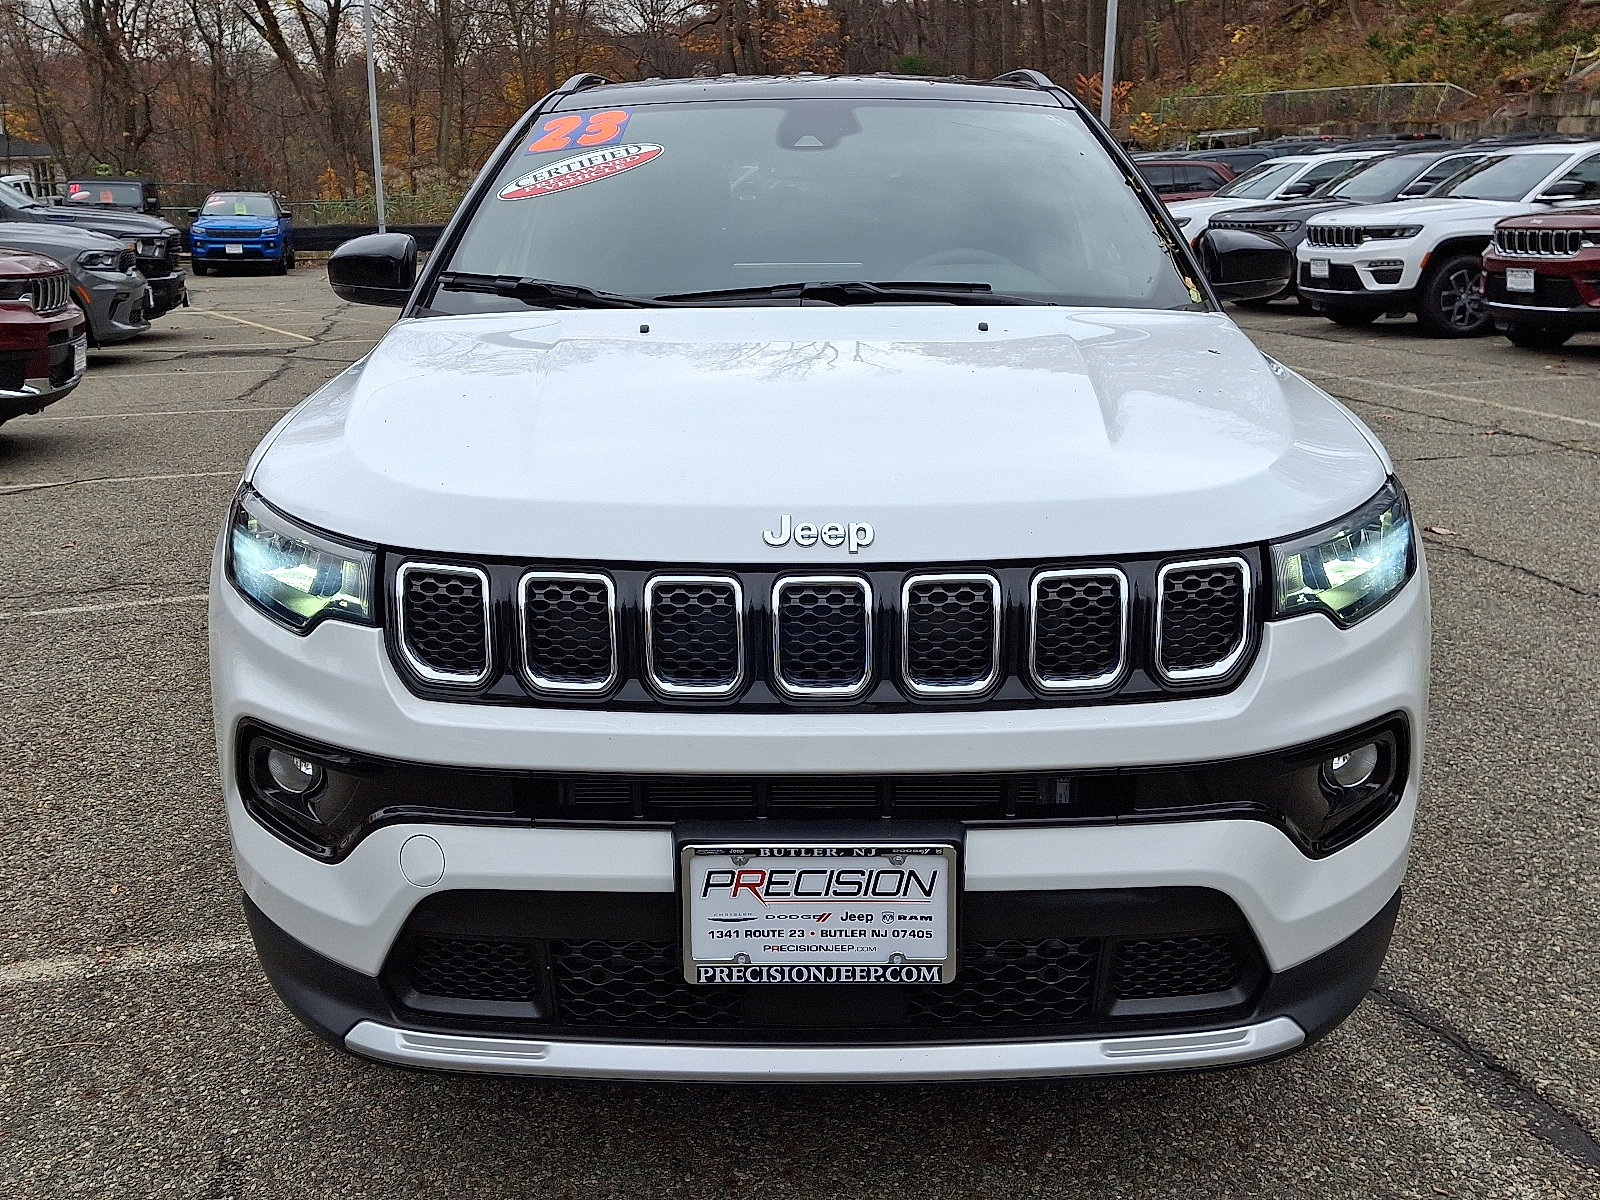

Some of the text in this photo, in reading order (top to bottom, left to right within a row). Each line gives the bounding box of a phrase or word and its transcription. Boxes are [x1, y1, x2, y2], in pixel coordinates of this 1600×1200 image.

[528, 110, 629, 153] 23
[515, 144, 642, 188] CERTIFIED
[545, 160, 628, 191] VEHICLE
[762, 514, 875, 554] Jeep
[852, 848, 877, 857] NJ
[701, 868, 939, 909] PRECISION
[840, 911, 874, 923] Jeep
[708, 929, 933, 939] 1341 ROUTE 23 BUTLER NJ 07405
[698, 966, 941, 983] PRECISIONJEEP.COM
